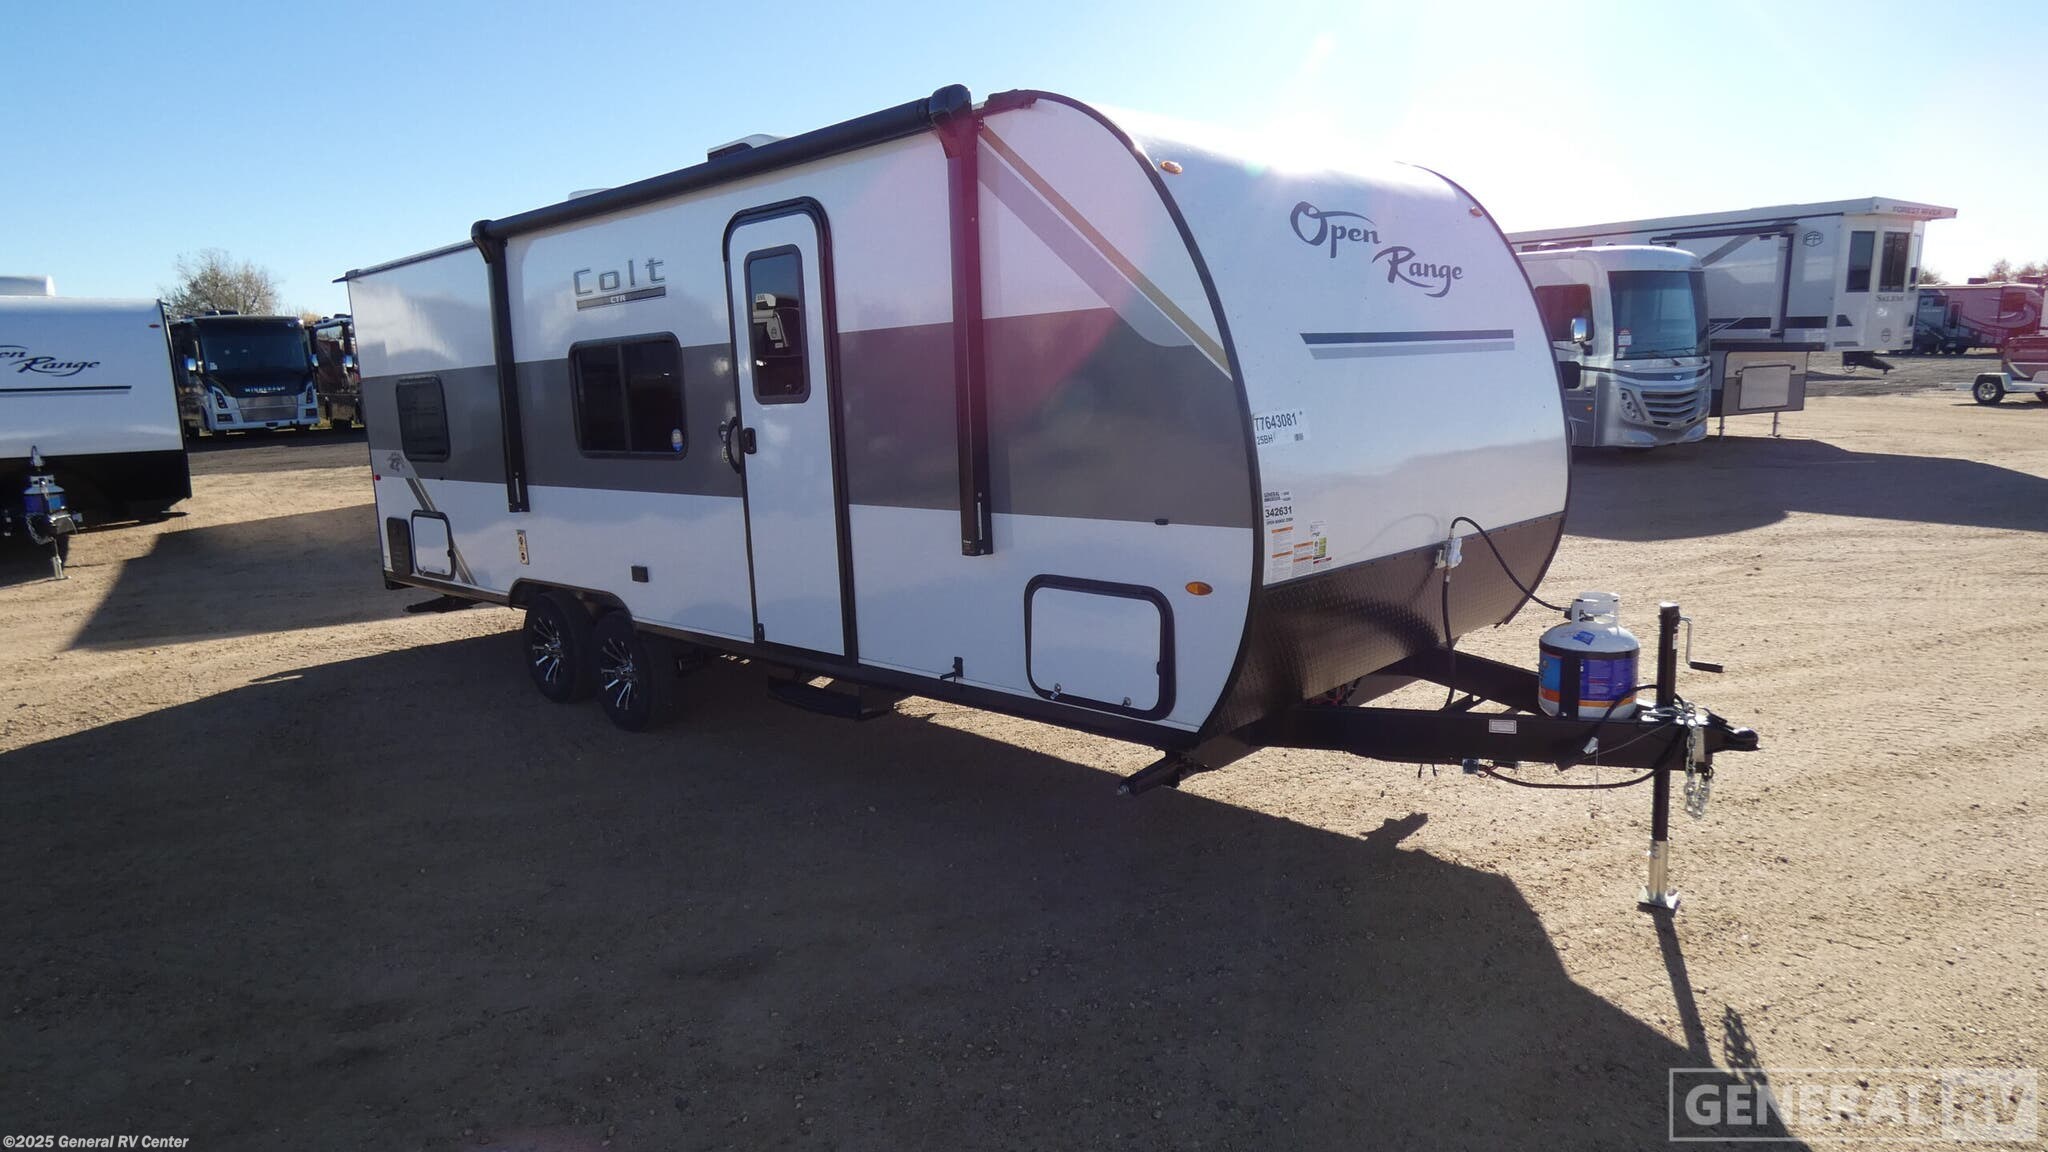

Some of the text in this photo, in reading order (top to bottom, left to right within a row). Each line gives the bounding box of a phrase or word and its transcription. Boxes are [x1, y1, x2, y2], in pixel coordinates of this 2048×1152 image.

[1290, 201, 1382, 259] Open
[574, 258, 665, 296] Colt
[1372, 246, 1463, 298] Range
[8, 356, 100, 377] Range
[1265, 506, 1292, 518] 342631
